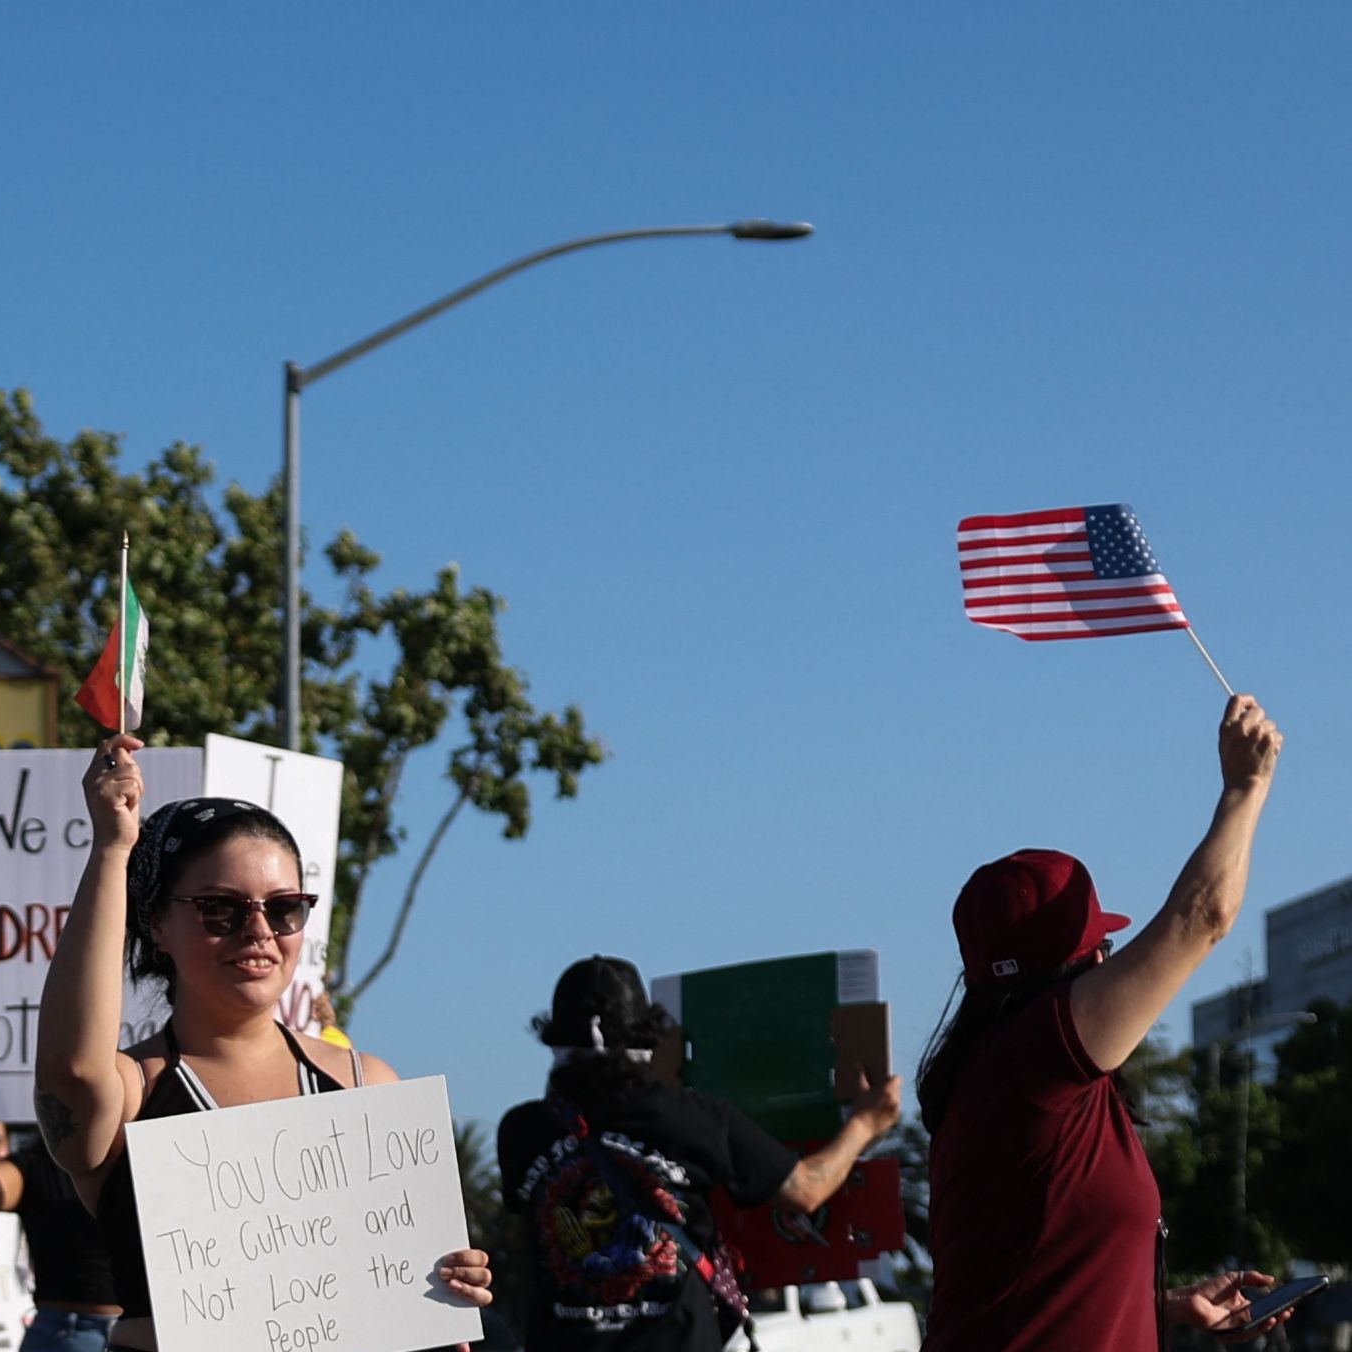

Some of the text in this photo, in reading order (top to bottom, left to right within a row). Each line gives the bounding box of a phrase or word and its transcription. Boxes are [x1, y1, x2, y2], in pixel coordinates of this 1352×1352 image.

[173, 1129, 267, 1212] You
[273, 1119, 349, 1201] Cant
[364, 1112, 440, 1182] Love
[156, 1189, 416, 1275] The Culture and
[181, 1254, 415, 1325] Not Love the
